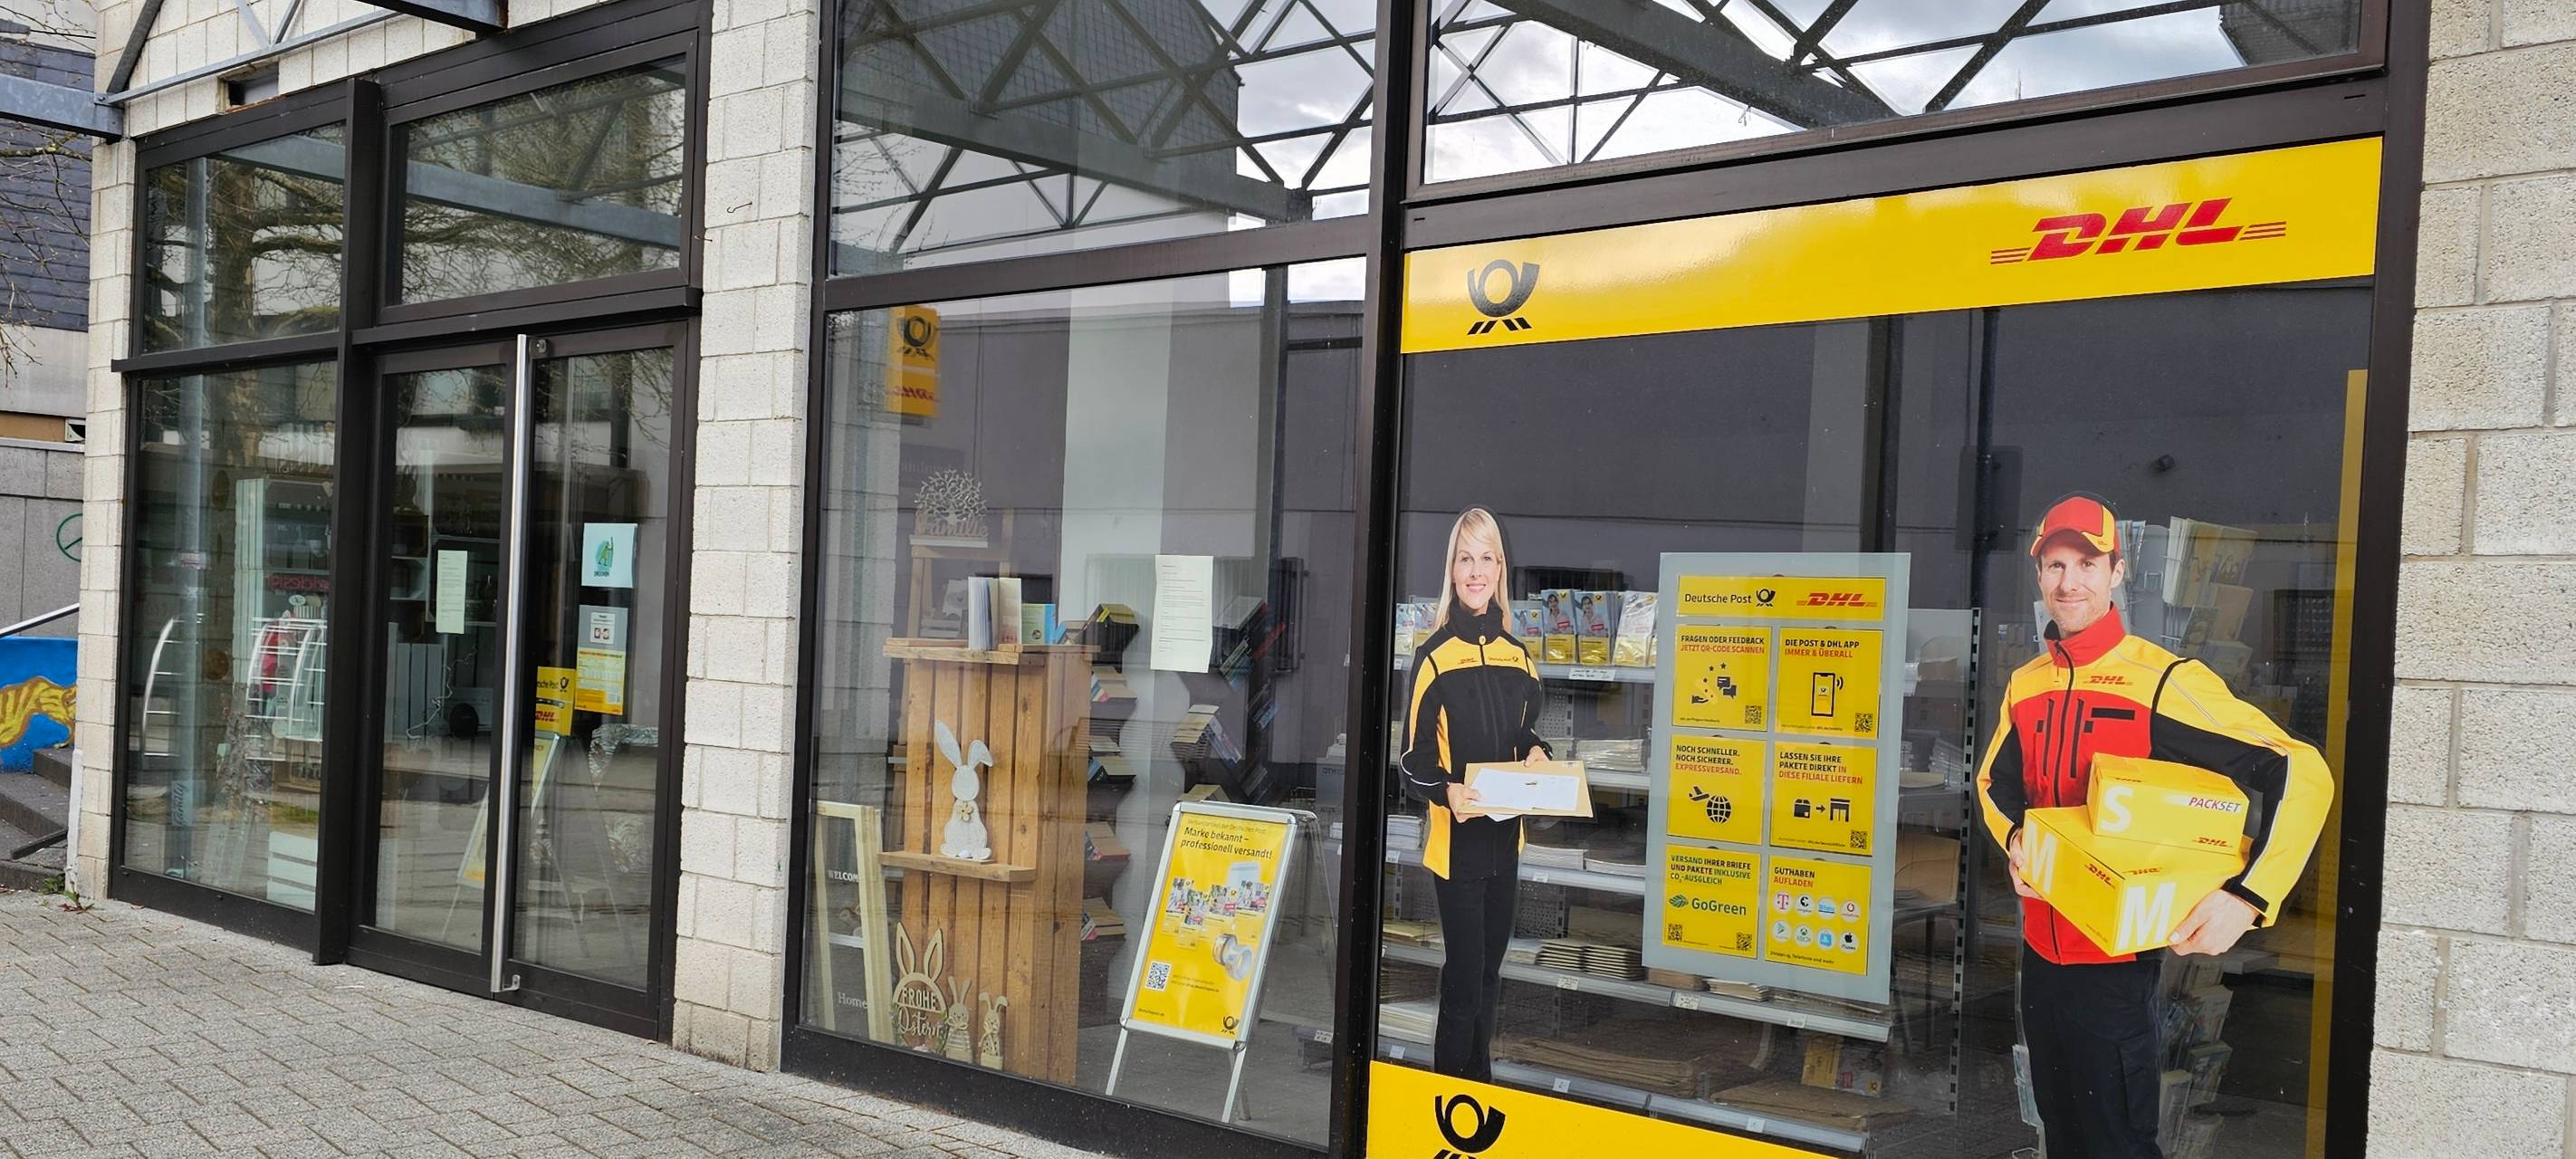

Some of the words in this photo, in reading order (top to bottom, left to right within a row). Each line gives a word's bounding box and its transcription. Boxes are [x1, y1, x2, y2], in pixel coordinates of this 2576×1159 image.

[2025, 196, 2246, 263] DHL
[1685, 593, 1728, 603] Deutsche
[1730, 594, 1751, 604] Post
[1806, 592, 1866, 607] DHL
[1681, 635, 1708, 643] FRAGEN
[1709, 636, 1728, 644] ODER
[1729, 637, 1765, 645] FEEDBACK
[1785, 638, 1797, 647] DIE
[1798, 639, 1819, 647] POST
[1826, 640, 1843, 648] DHL
[1681, 644, 1700, 652] JETZT
[1700, 645, 1730, 653] QR-CODE
[1731, 646, 1765, 654] SCANNEN
[1785, 648, 1810, 656] IMMER
[1811, 649, 1817, 657] &
[1818, 647, 1853, 658] ÜBERALL
[2088, 675, 2126, 685] DHL
[1676, 745, 1696, 753] NOCH
[1697, 746, 1740, 757] SCHNELLER.
[1779, 752, 1808, 761] LASSEN
[1809, 753, 1822, 761] SIE
[1823, 754, 1842, 763] IHRE
[1675, 754, 1695, 762] NOCH
[1696, 755, 1734, 765] SICHERER.
[1675, 762, 1742, 775] EXPRESSVERSAND.
[1779, 761, 1808, 771] PAKETE
[1809, 763, 1837, 772] DIREKT
[1778, 771, 1801, 780] DIESE
[1801, 772, 1829, 781] FILIALE
[1831, 775, 1863, 784] LIEFERN
[2102, 785, 2133, 832] S
[2188, 797, 2242, 812] PACKSET
[1183, 826, 1209, 838] Marke
[1210, 830, 1243, 843] bekannt
[1180, 838, 1233, 854] professionell
[1233, 846, 1273, 859] versandt!
[2197, 837, 2228, 848] DHL
[1671, 854, 1703, 865] VERSAND
[1703, 858, 1725, 867] IHRER
[1726, 860, 1751, 870] BRIEFE
[2023, 819, 2059, 895] M
[828, 869, 860, 883] WELCOM
[1671, 864, 1686, 872] UND
[1686, 866, 1713, 875] PAKETE
[1713, 868, 1751, 879] INKLUSIVE
[1774, 867, 1815, 878] GUTHABEN
[2088, 863, 2113, 888] DHL
[1773, 876, 1814, 887] AUFLADEN
[1691, 897, 1747, 916] GoGreen
[2117, 882, 2177, 952] M
[837, 991, 869, 1010] Home
[902, 987, 938, 1011] FROHE
